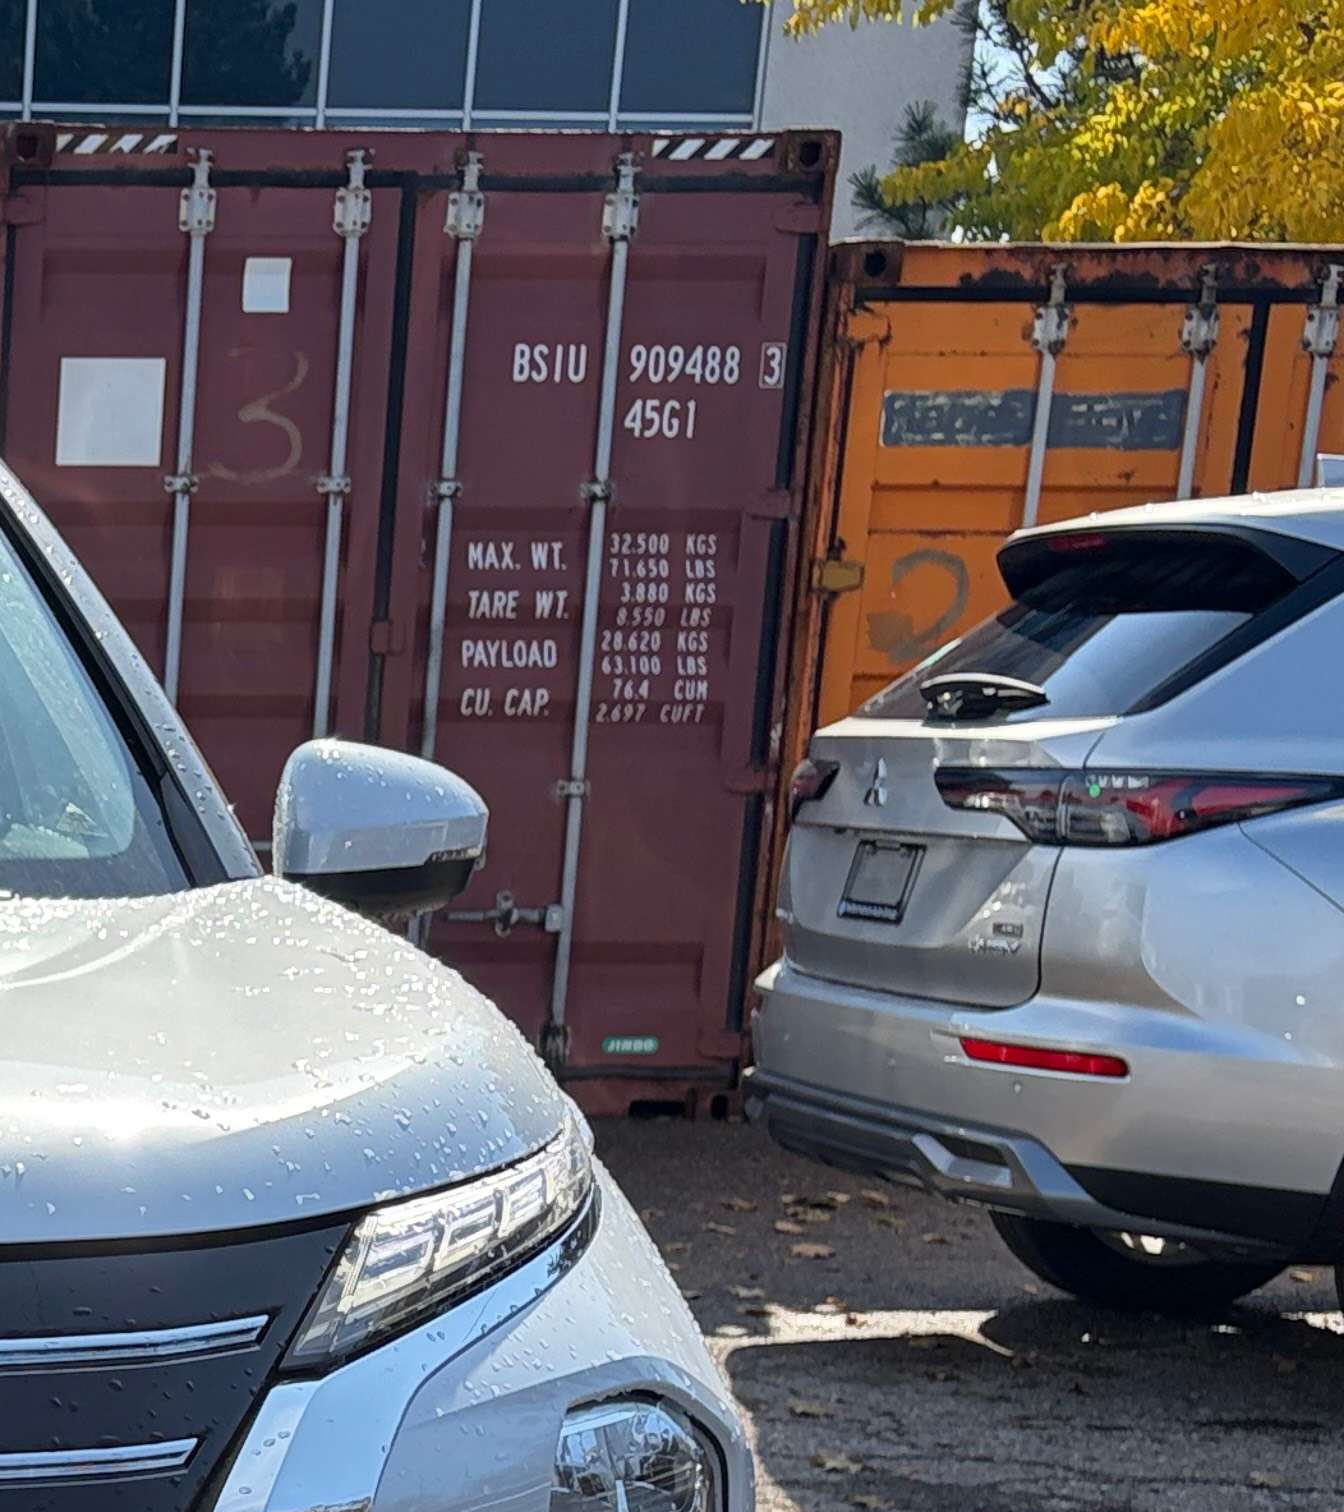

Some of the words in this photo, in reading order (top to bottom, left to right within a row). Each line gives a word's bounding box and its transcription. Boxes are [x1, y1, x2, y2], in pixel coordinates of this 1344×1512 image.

[512, 343, 587, 383] BSIU
[629, 345, 741, 384] 909488
[763, 346, 783, 385] 3
[624, 399, 697, 438] 45G1
[610, 533, 669, 555] 32.500
[686, 534, 717, 555] KGS
[468, 542, 521, 570] MAX.
[531, 541, 567, 570] WT.
[610, 558, 669, 578] 71.650
[686, 559, 716, 578] LBS
[620, 583, 669, 603] 3.880
[685, 583, 716, 603] KGS
[468, 590, 520, 619] TARE
[535, 591, 569, 619] WT.
[616, 607, 666, 627] 8.550
[681, 607, 712, 627] LBS
[601, 631, 661, 651] 28.620
[677, 631, 709, 651] KGS
[461, 639, 557, 668] PAYLOAD
[601, 656, 661, 675] 63.100
[677, 655, 708, 675] LBS
[613, 680, 649, 699] 76.4
[674, 679, 708, 700] CUM
[461, 688, 493, 716] CU.
[504, 688, 550, 716] CAP.
[596, 703, 646, 723] 2.697
[660, 703, 704, 723] CUFT
